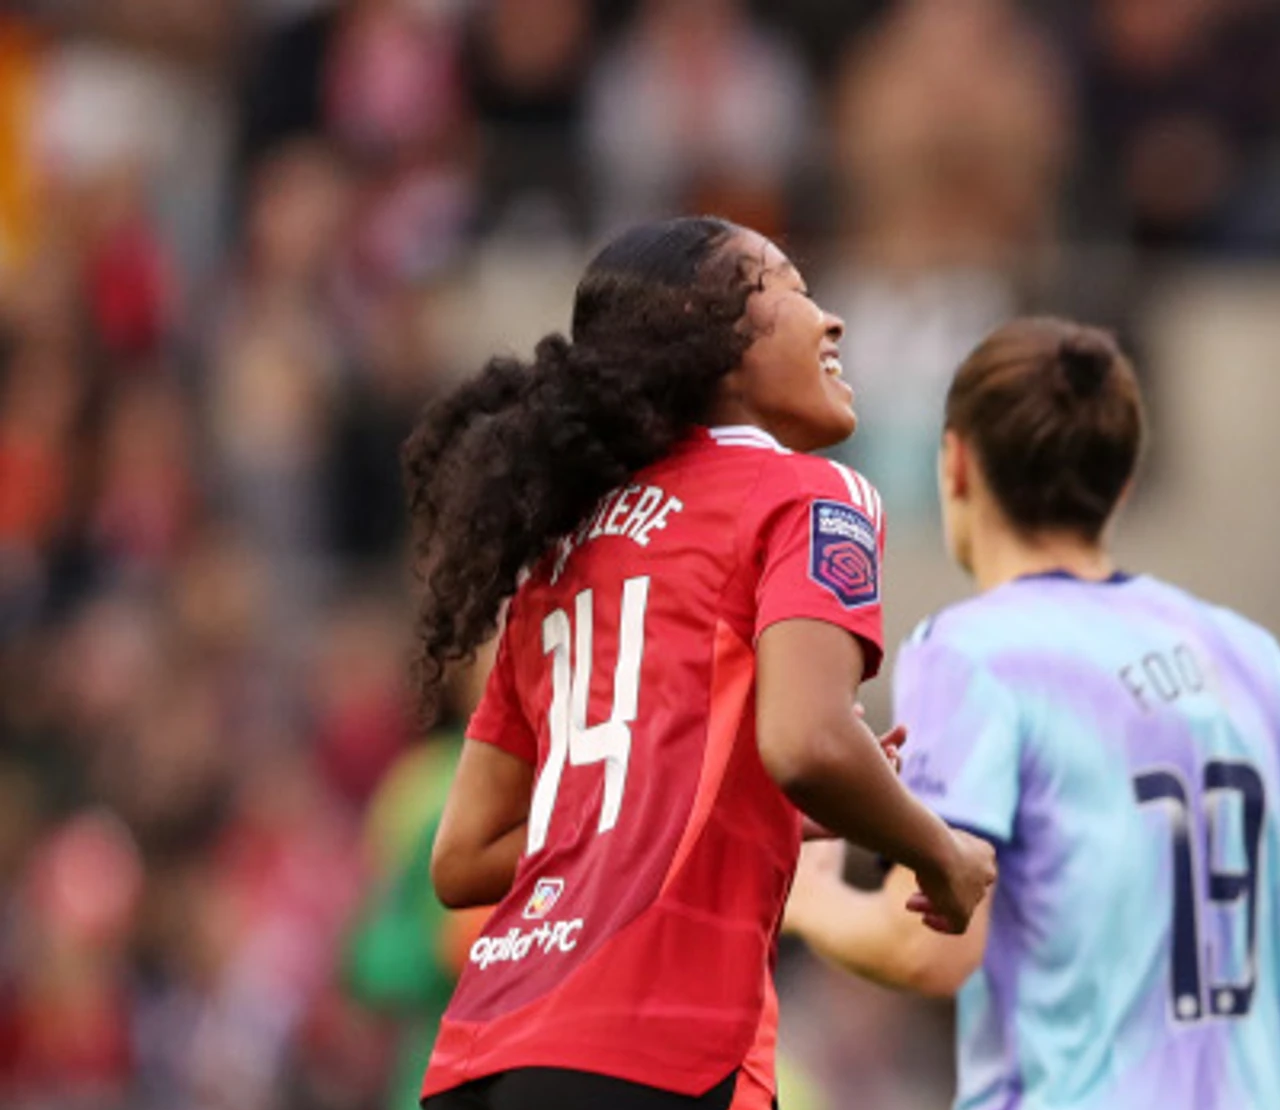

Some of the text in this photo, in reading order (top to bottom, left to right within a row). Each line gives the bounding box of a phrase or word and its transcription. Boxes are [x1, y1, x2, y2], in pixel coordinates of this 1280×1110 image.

[527, 576, 650, 857] 14
[1118, 644, 1204, 713] FOO
[1131, 760, 1264, 1022] 19
